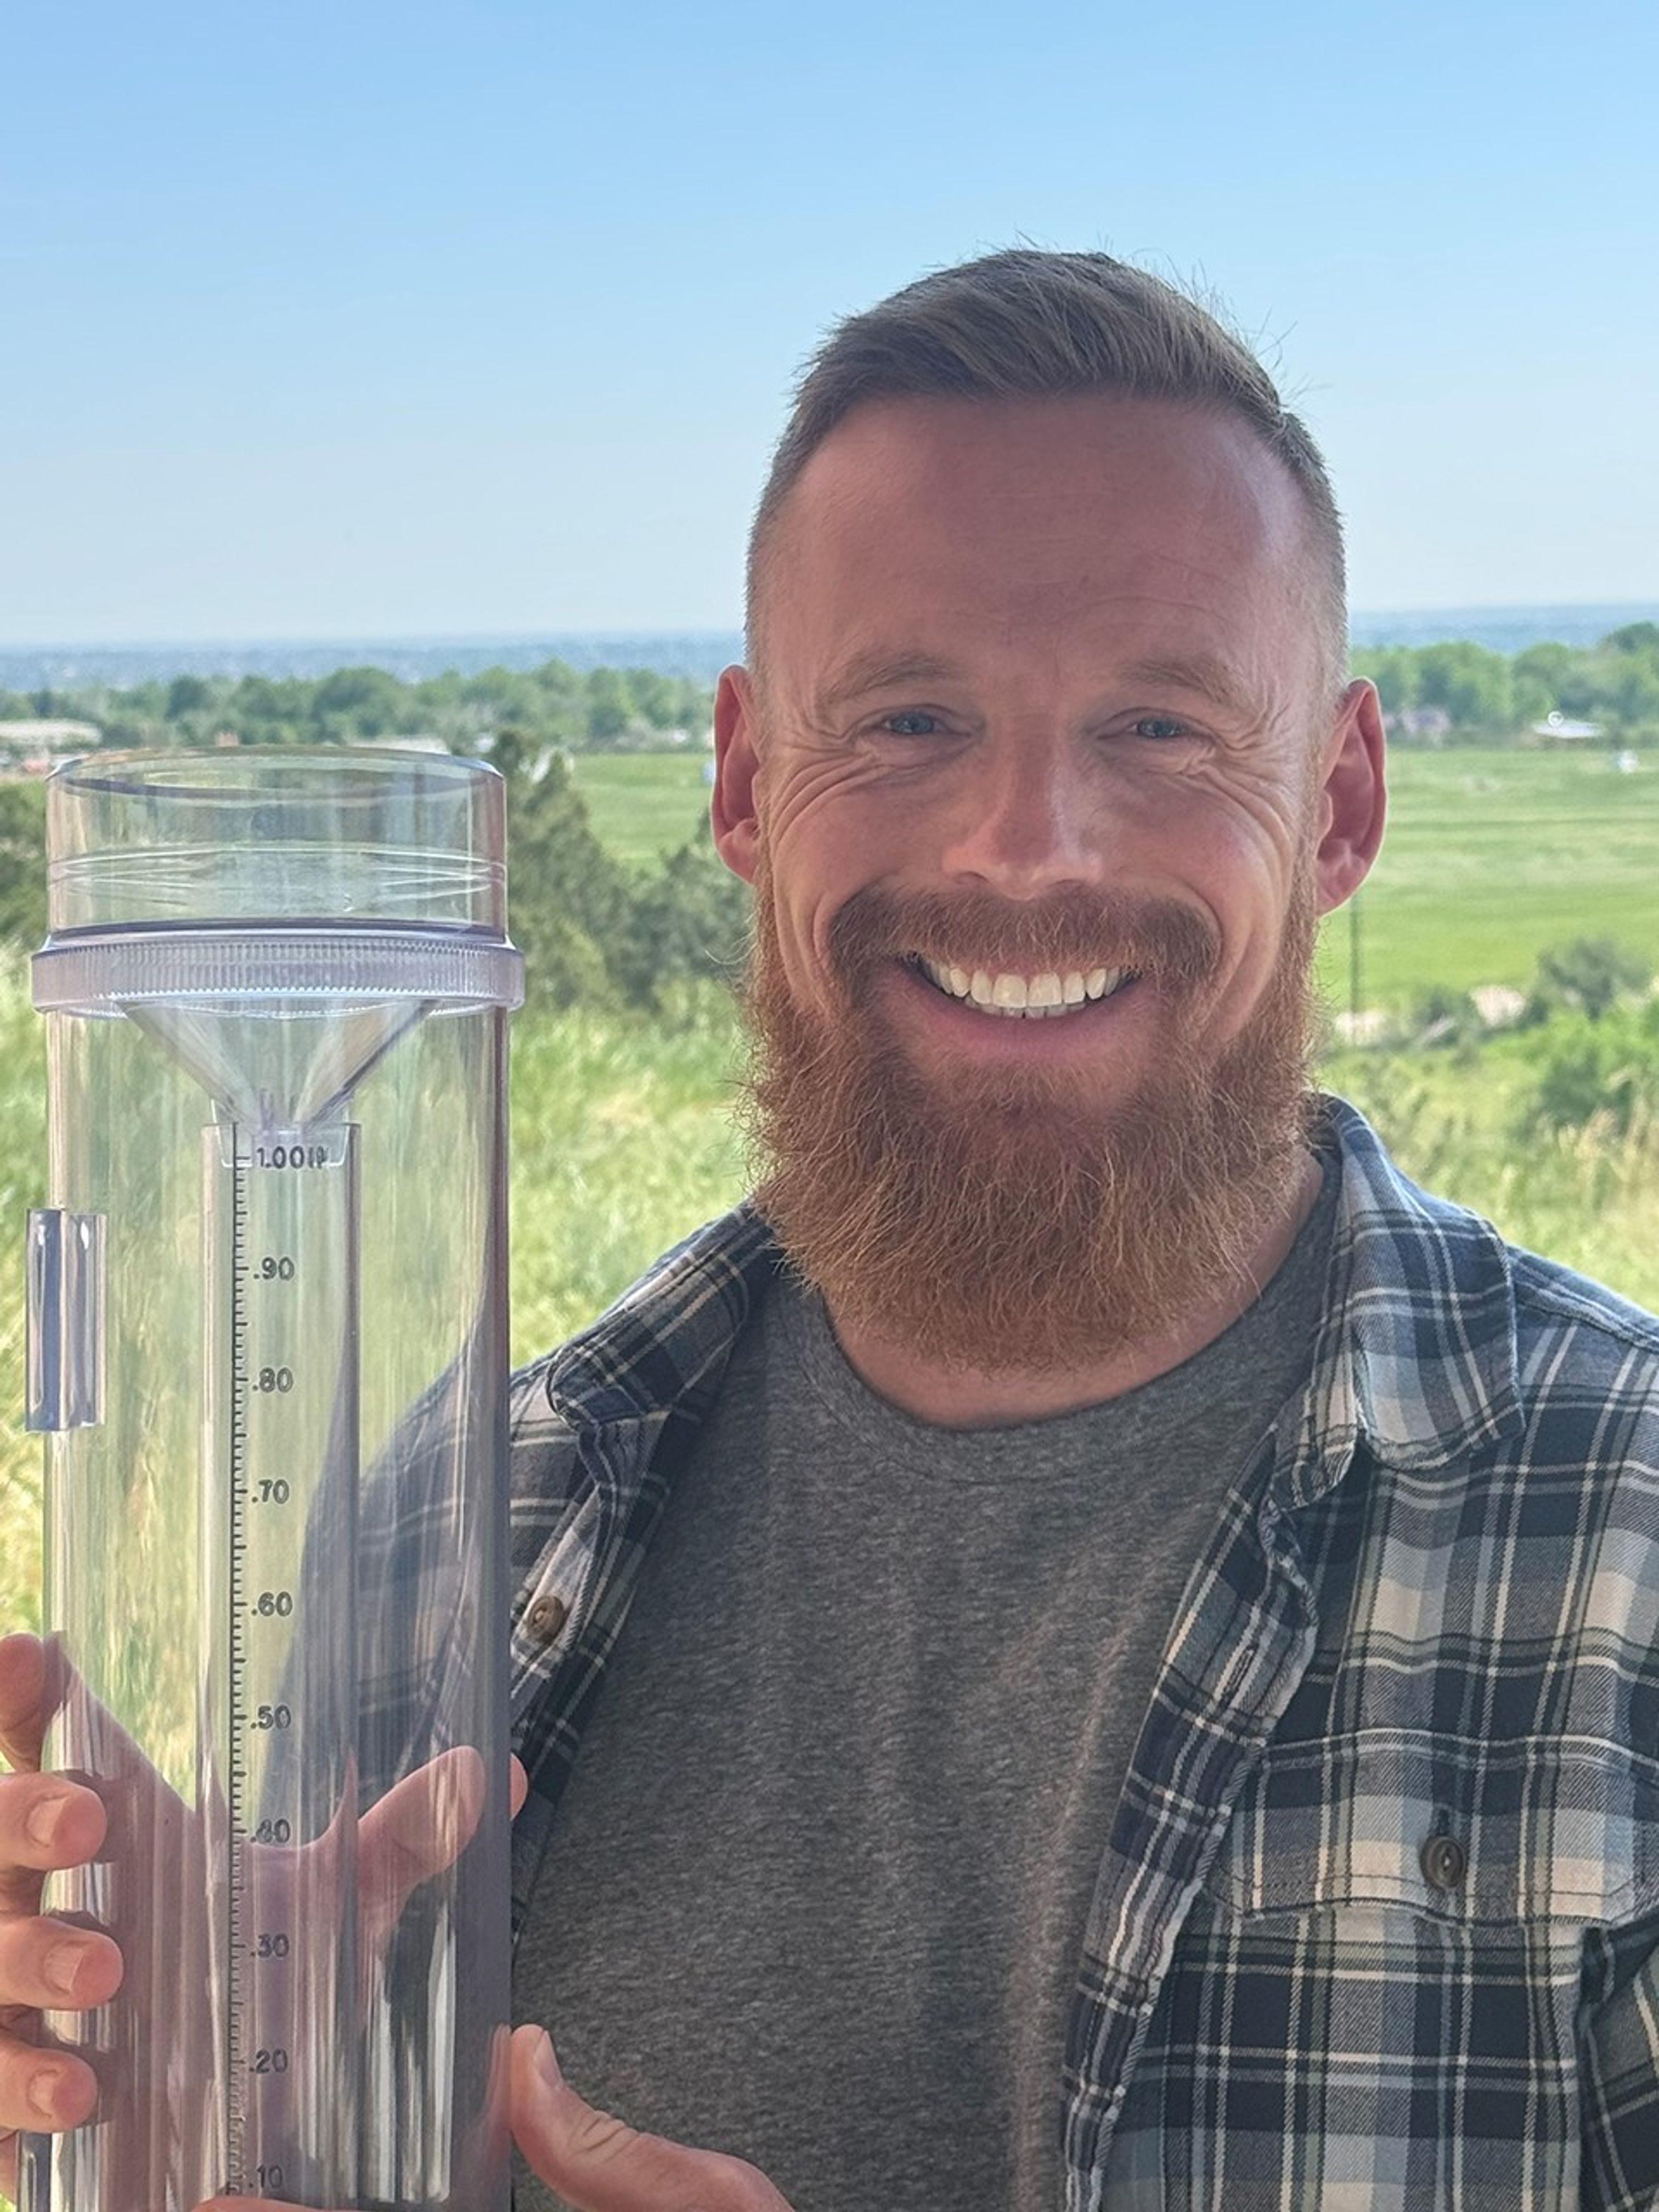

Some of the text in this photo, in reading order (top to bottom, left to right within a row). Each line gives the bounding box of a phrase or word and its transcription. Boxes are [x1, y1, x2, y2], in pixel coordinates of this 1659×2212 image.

[253, 1257, 295, 1280] .90
[252, 1367, 294, 1393] .80
[251, 1479, 290, 1504] .70
[251, 1591, 292, 1616] .60
[251, 1705, 291, 1729] .50
[250, 1933, 289, 1957] .30
[249, 2048, 288, 2074] .20
[249, 2165, 283, 2188] .10
